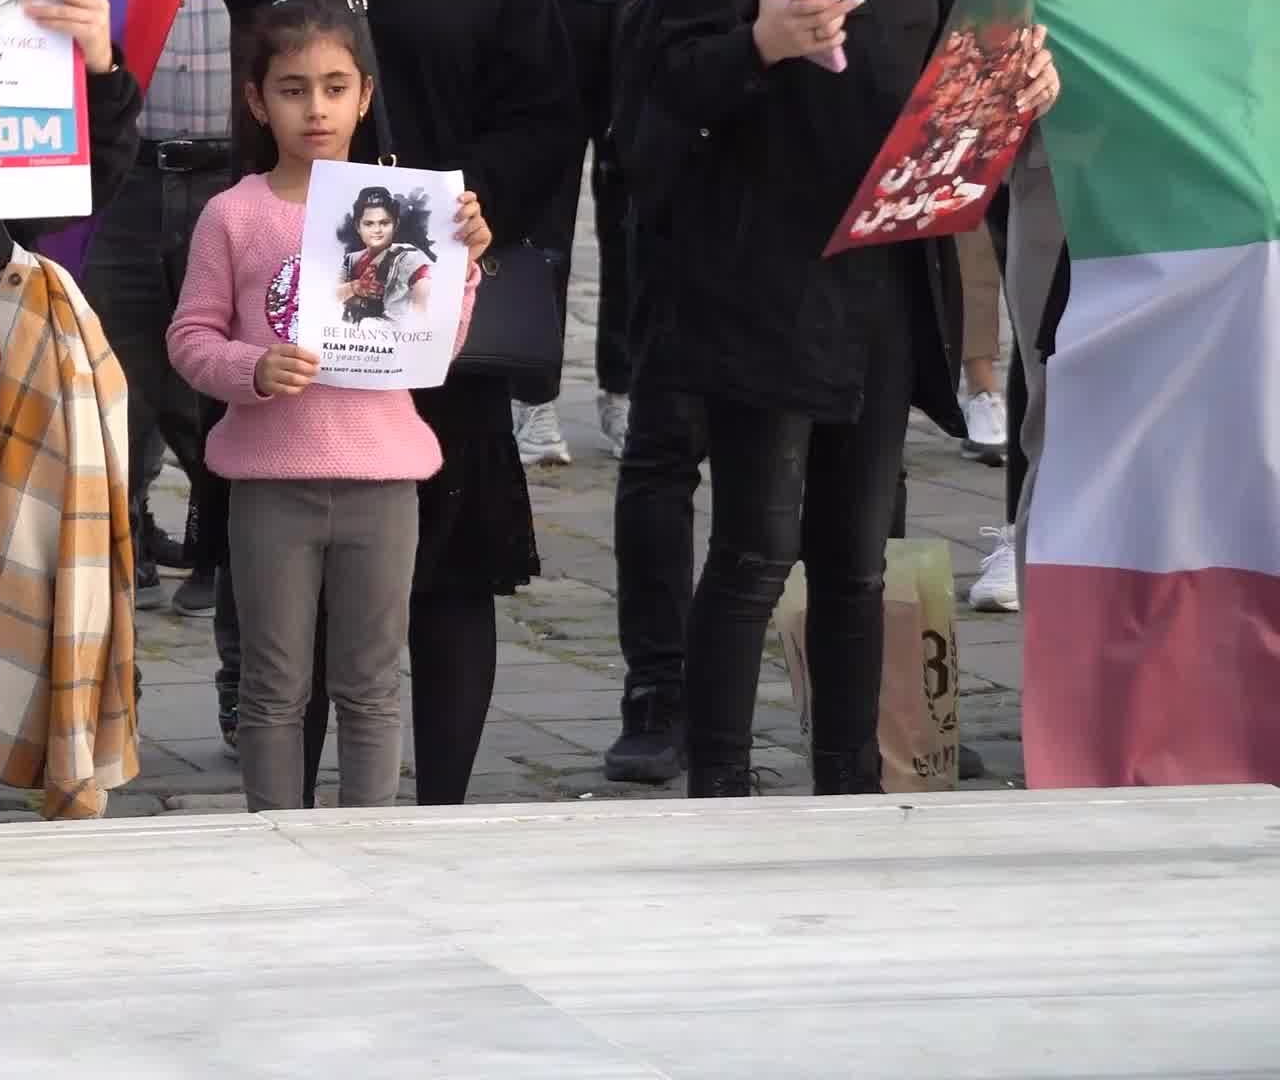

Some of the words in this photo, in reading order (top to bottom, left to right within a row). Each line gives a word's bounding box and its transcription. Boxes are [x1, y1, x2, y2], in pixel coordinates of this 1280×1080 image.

[323, 326, 340, 338] BE
[392, 331, 433, 342] VOICE
[323, 342, 346, 351] KIAN
[349, 344, 394, 354] PIRFALAK
[322, 352, 333, 360] 10
[363, 354, 380, 362] old
